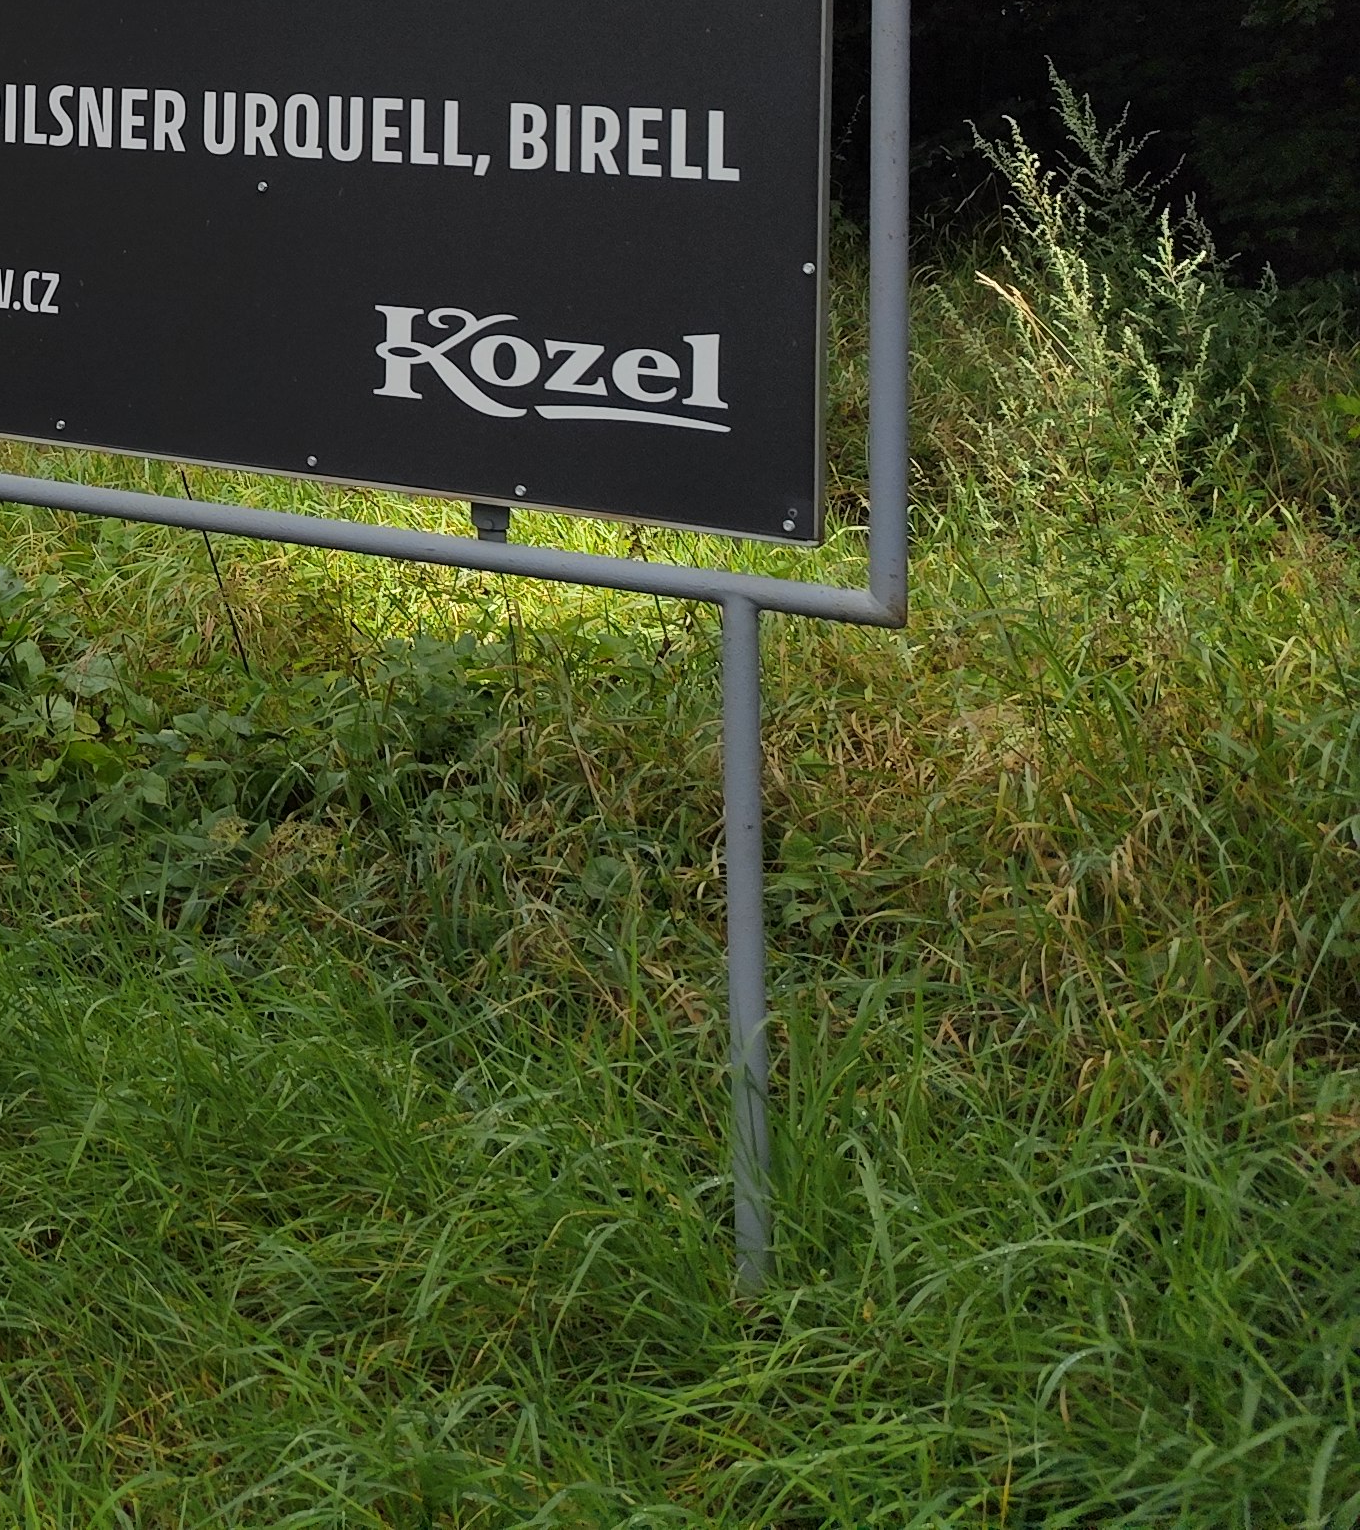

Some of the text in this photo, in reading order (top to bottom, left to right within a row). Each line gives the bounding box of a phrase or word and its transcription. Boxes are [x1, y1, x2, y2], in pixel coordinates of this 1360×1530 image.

[204, 91, 490, 176] URQUELL,
[510, 103, 739, 181] BIRELL
[373, 305, 728, 417] Kozel
